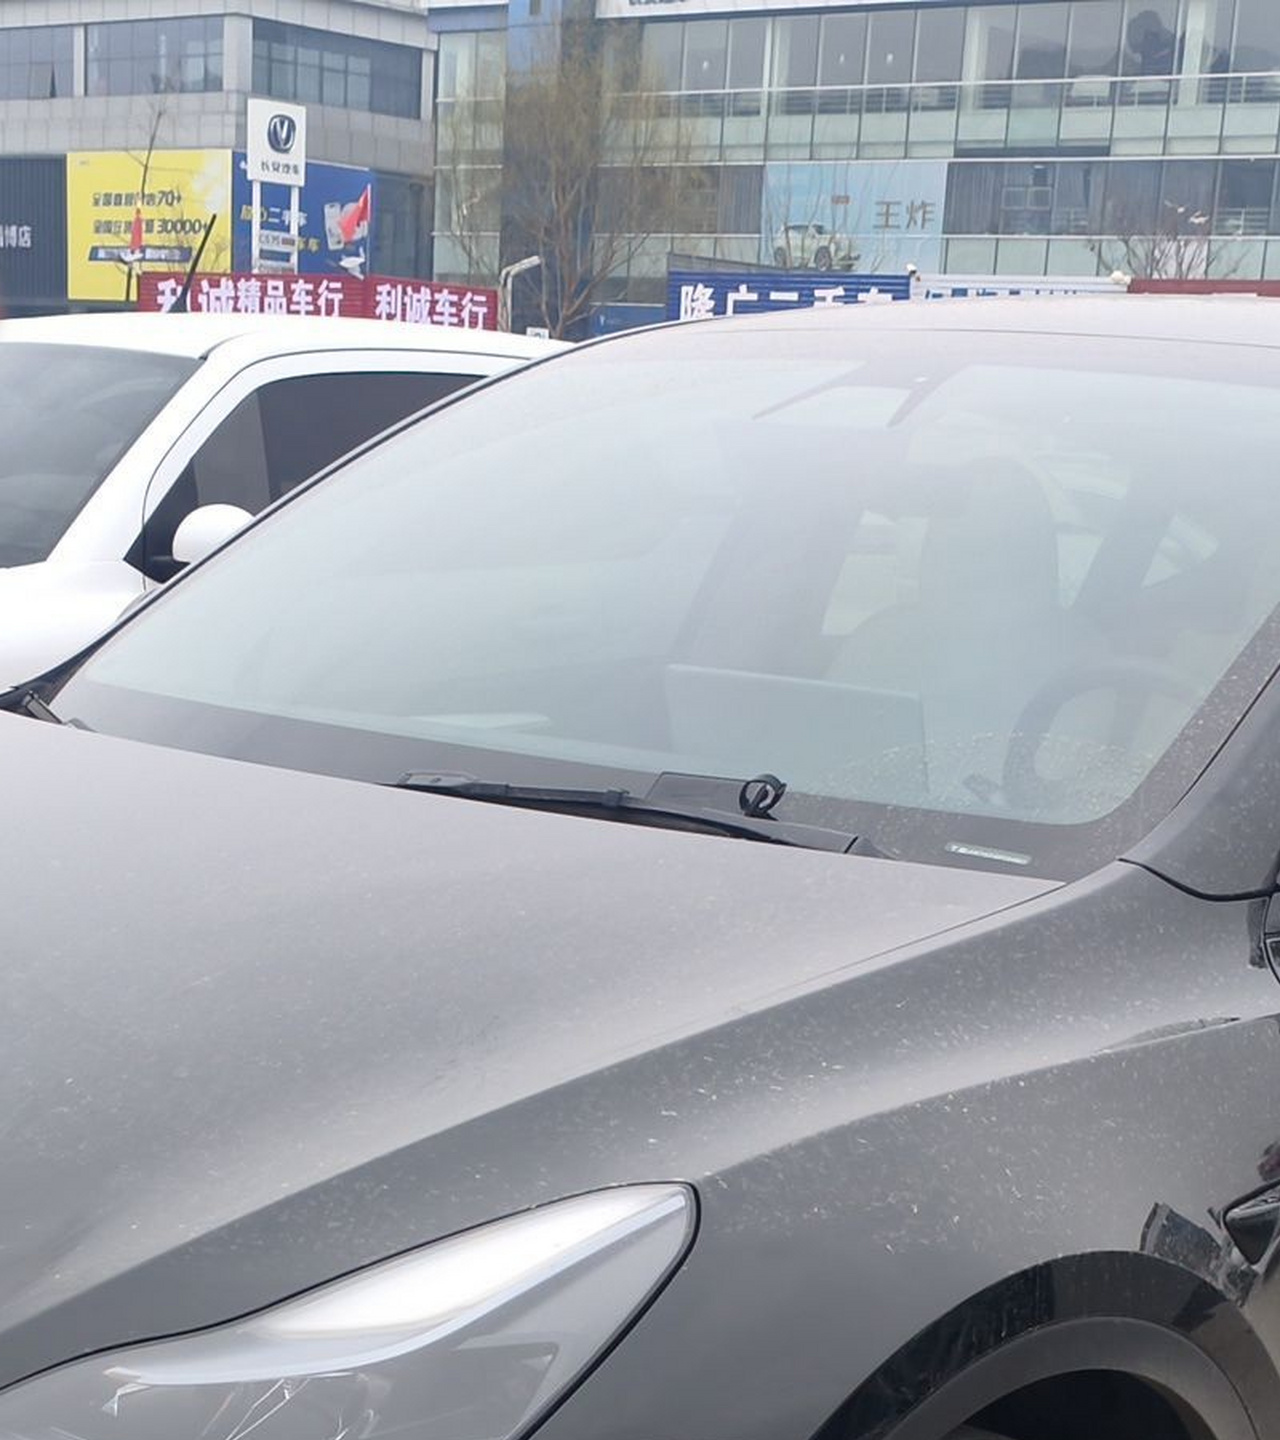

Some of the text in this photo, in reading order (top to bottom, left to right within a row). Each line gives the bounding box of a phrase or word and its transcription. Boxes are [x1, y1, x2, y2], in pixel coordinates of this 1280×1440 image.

[873, 200, 936, 230] 王炸
[375, 283, 489, 330] 利诚车行
